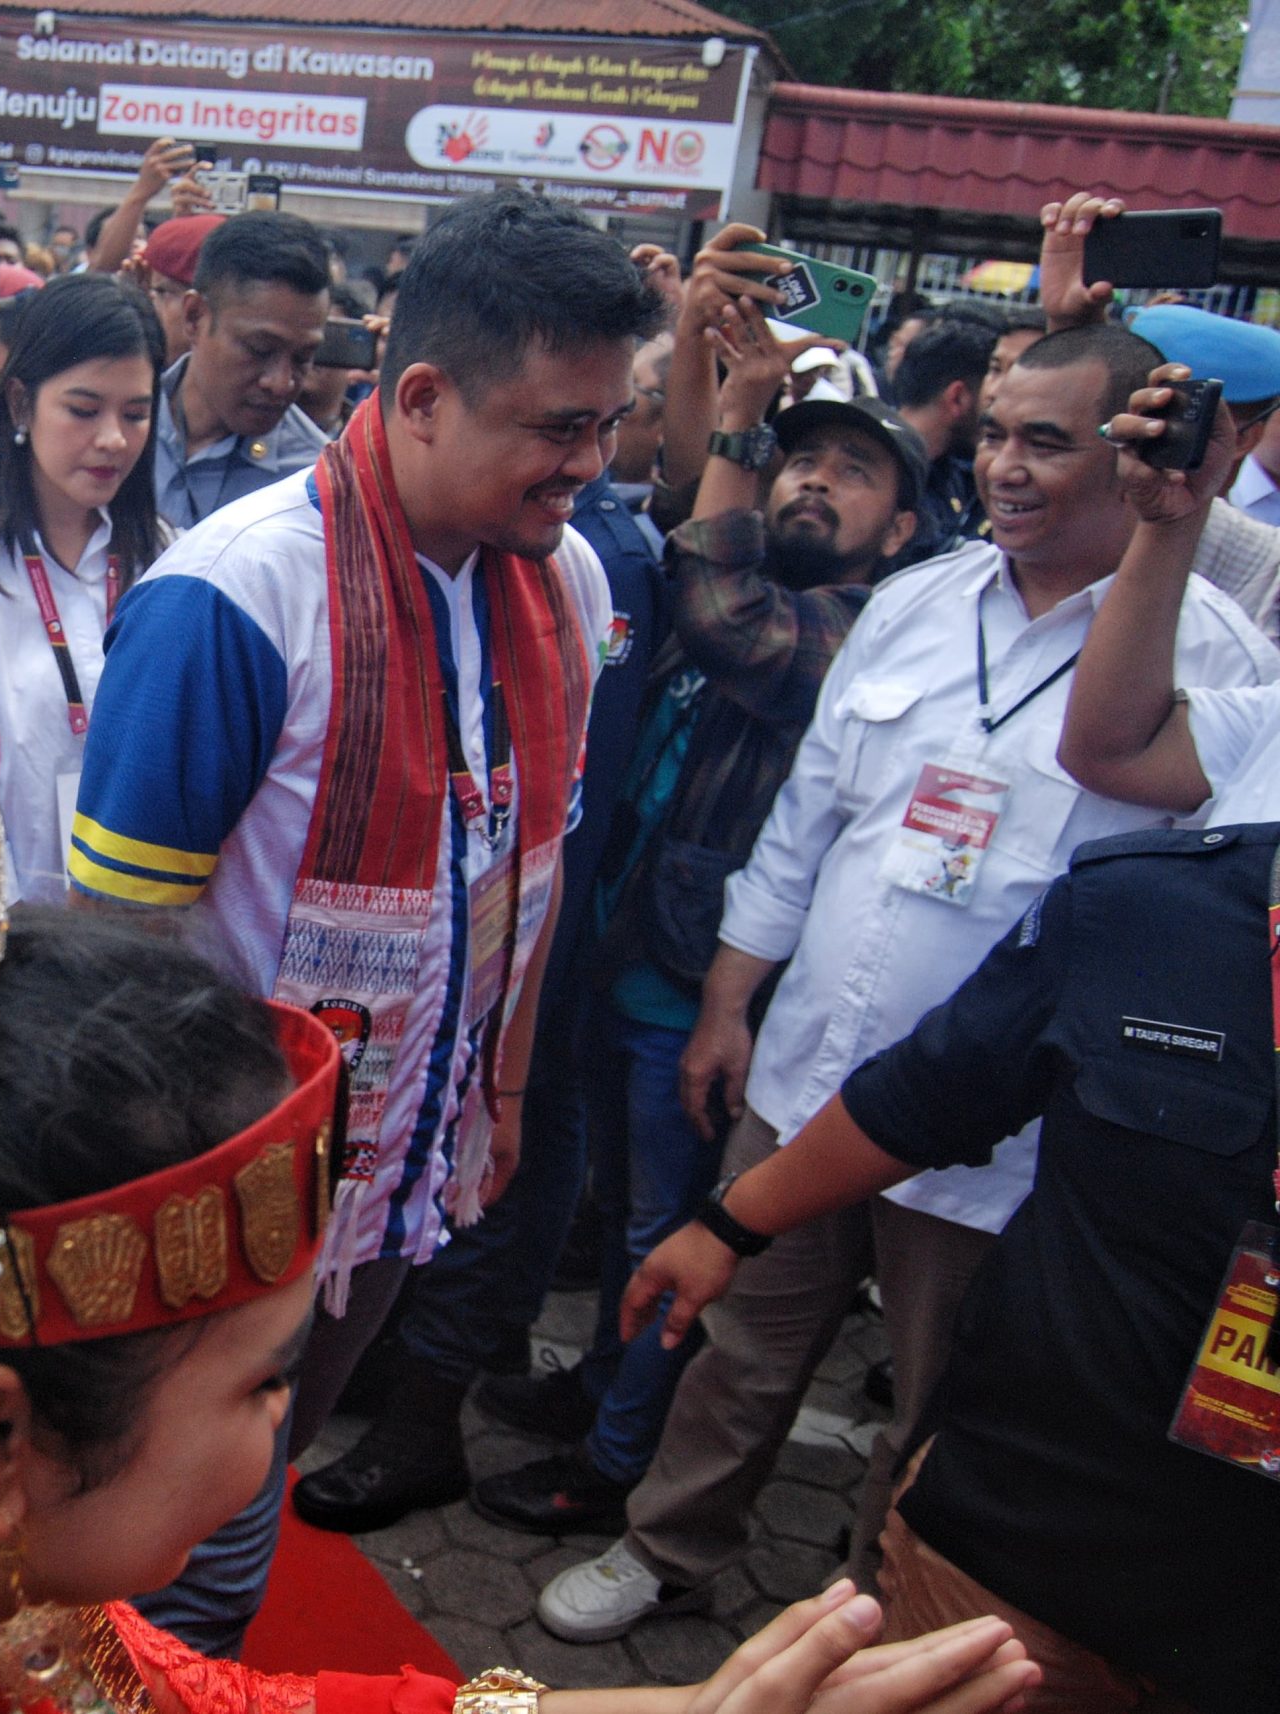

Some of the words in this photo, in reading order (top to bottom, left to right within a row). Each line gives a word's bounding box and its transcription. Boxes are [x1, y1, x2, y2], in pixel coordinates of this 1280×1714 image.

[17, 35, 135, 66] Selamat
[139, 39, 248, 79] Datang
[253, 41, 284, 72] di
[288, 45, 434, 81] Kawasan
[104, 95, 184, 126] Zona
[192, 100, 359, 140] Integritas
[322, 1000, 364, 1014] KOMISI
[1136, 1028, 1172, 1044] TAUFIK
[1171, 1034, 1218, 1052] SIREGAR
[1210, 1324, 1280, 1375] PAN
